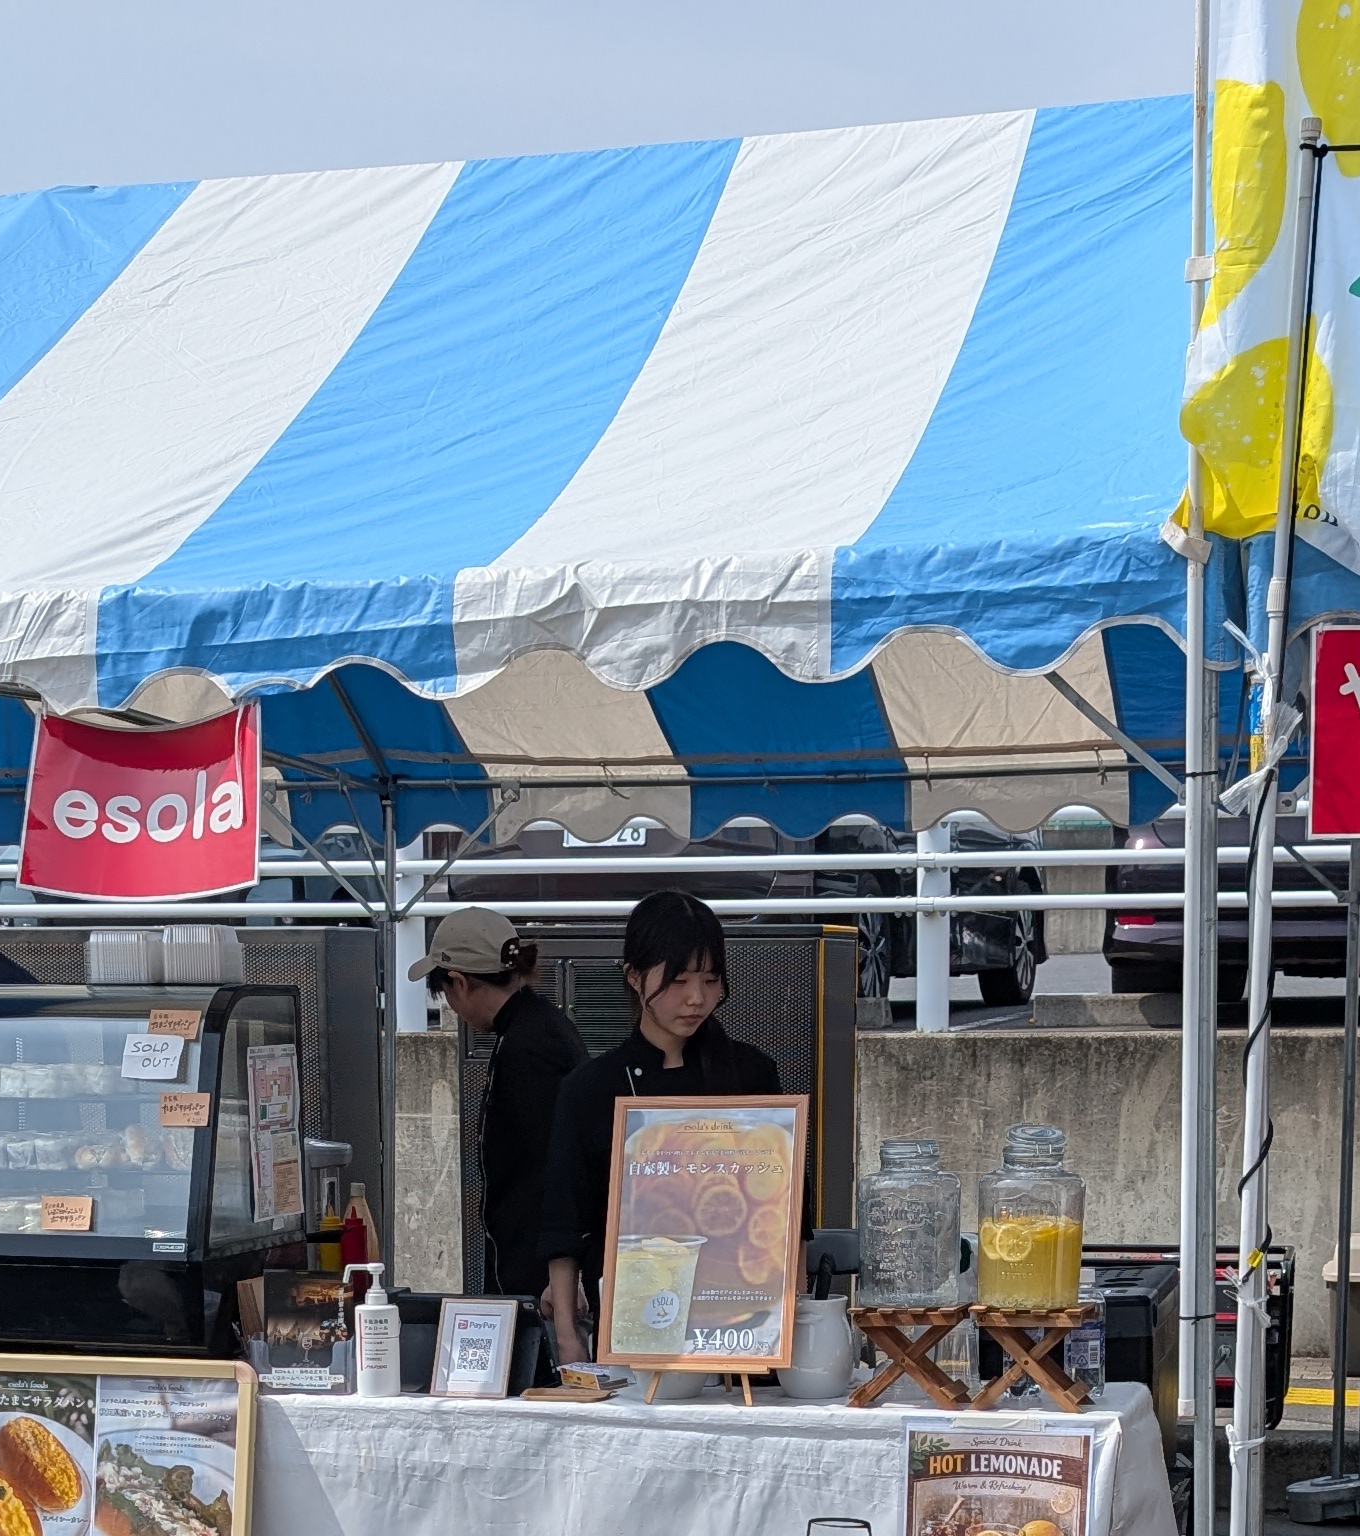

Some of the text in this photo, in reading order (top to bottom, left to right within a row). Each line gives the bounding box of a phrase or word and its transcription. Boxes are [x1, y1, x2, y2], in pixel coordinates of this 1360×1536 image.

[52, 769, 244, 844] esola
[130, 1041, 170, 1054] SOLD
[141, 1056, 177, 1068] OUT!
[628, 1160, 784, 1177] 自家製レモンスカッシュ
[469, 1320, 498, 1331] PayPay
[692, 1327, 755, 1351] ¥400
[969, 1436, 1023, 1448] Special Drink
[928, 1453, 1064, 1480] HOT LEMONADE
[979, 1481, 987, 1490] &
